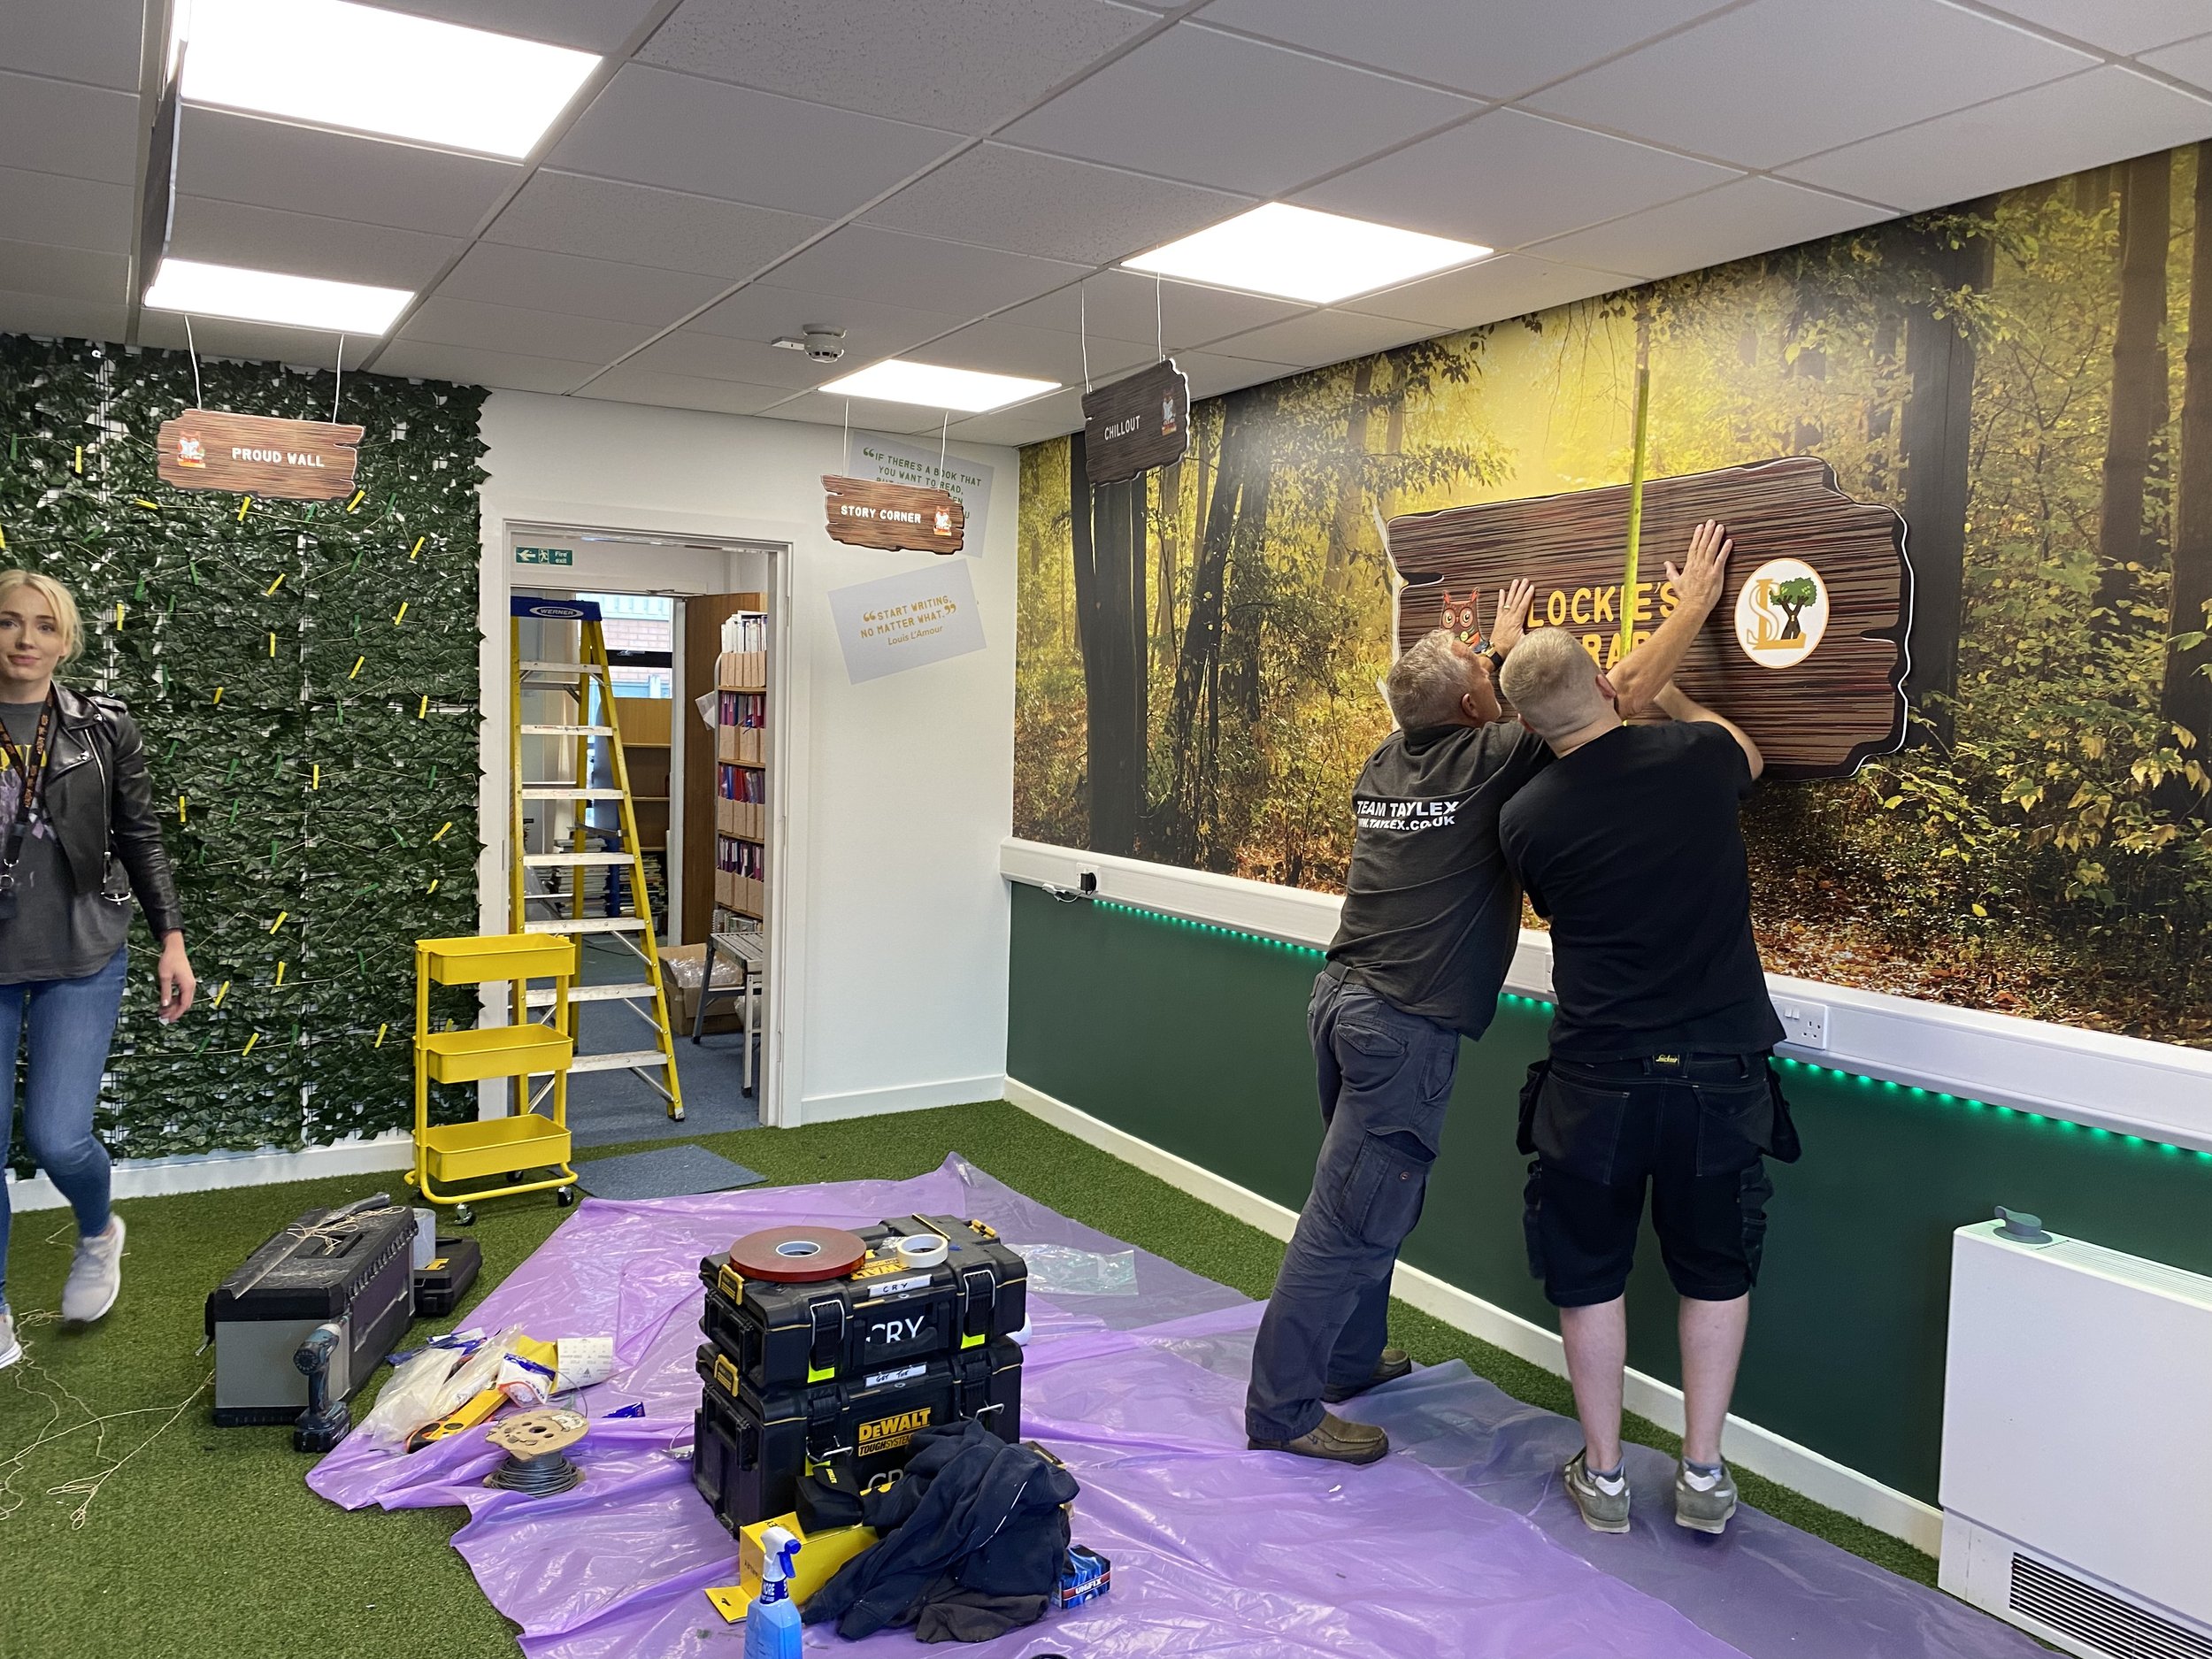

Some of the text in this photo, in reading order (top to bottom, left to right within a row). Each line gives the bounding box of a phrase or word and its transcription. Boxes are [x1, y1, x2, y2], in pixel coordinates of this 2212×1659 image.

[1104, 415, 1141, 441] CHILLOUT
[232, 447, 325, 468] PROUD WALL
[879, 465, 896, 477] YOU
[899, 471, 922, 484] WANT
[926, 478, 936, 487] TO
[940, 481, 964, 495] READ,
[926, 465, 931, 474] A
[933, 467, 957, 480] BOOK
[961, 474, 982, 487] THAT
[841, 505, 921, 524] STORY CORNER
[910, 595, 952, 612] WRITING,
[860, 628, 874, 638] NO
[877, 617, 915, 635] MATTER
[887, 625, 944, 646] Louis L'Amour
[1356, 800, 1460, 817] TEAM TAYLEX
[882, 1282, 909, 1293] CRY
[858, 1409, 931, 1441] DEWALT
